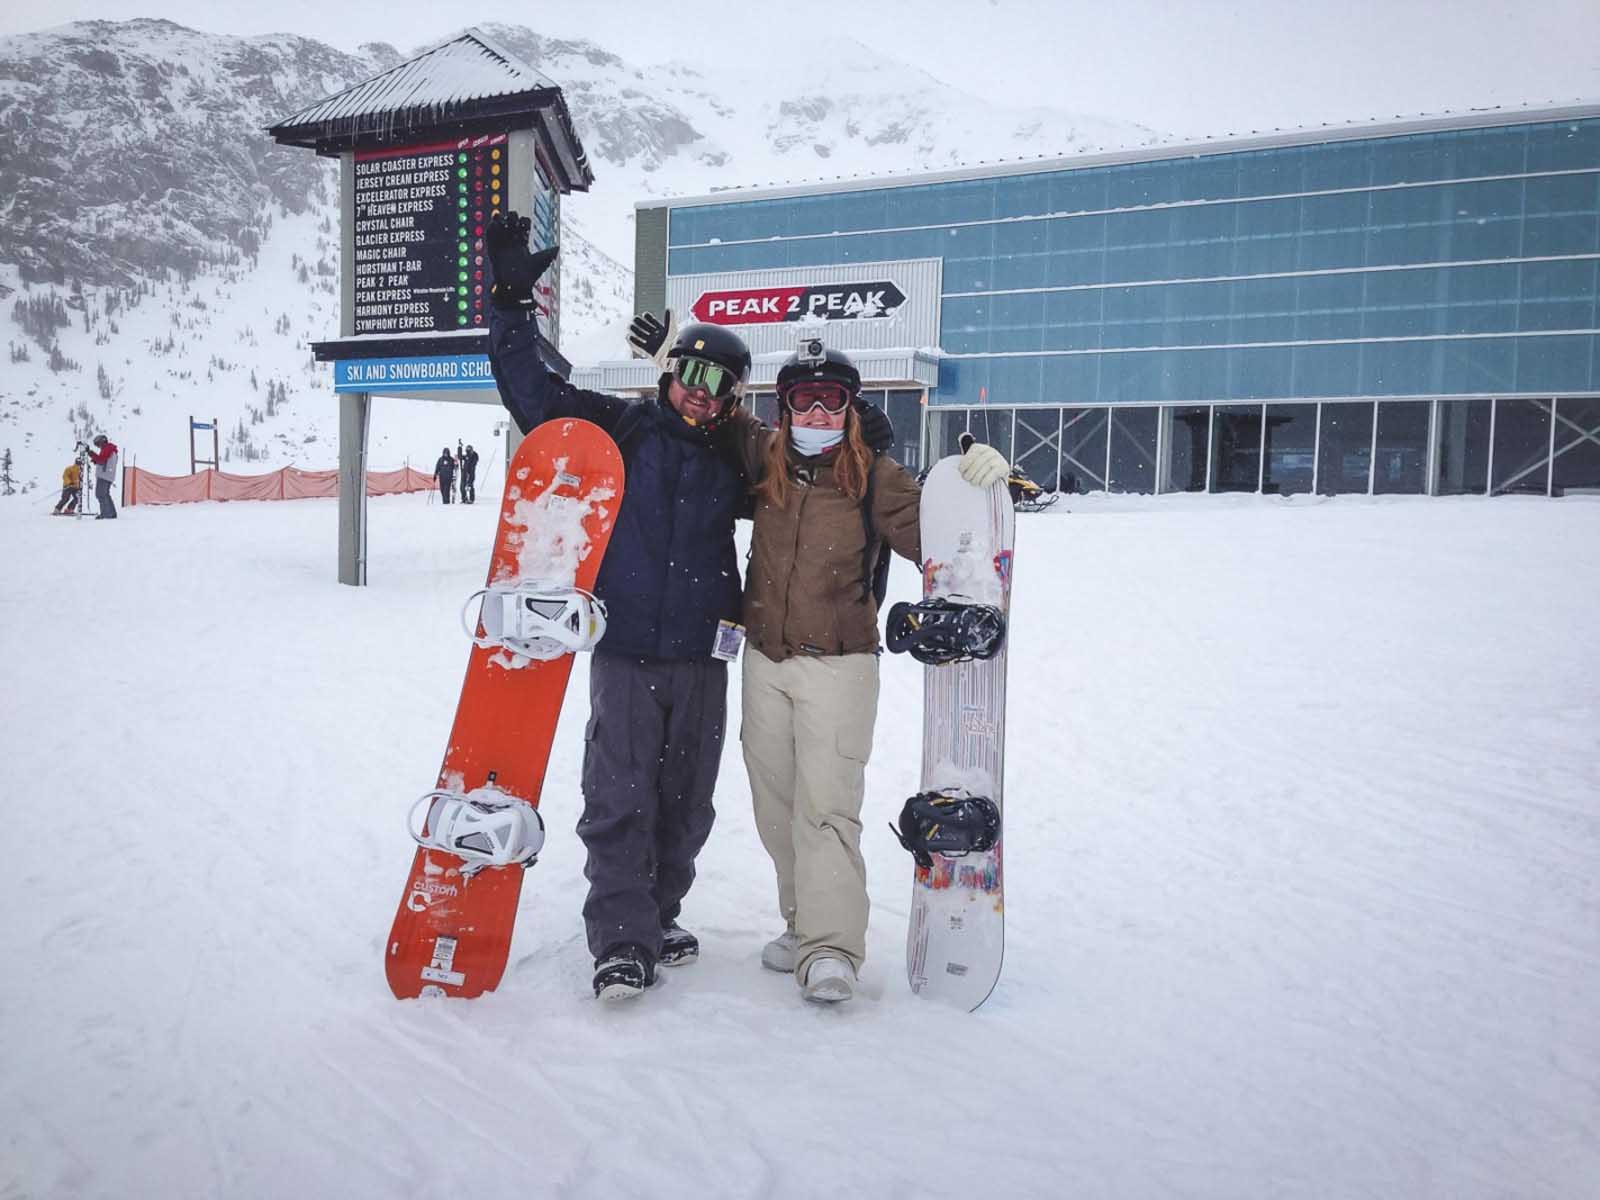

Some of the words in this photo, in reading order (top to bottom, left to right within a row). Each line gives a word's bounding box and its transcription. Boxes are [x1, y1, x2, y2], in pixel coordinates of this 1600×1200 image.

[356, 164, 381, 176] SOLAR
[381, 158, 417, 173] COASTER
[418, 154, 454, 168] EXPRESS
[356, 178, 384, 190] JERSEY
[385, 174, 413, 187] CREAM
[413, 170, 450, 184] EXPRESS
[356, 189, 409, 204] EXCELERATOR
[410, 185, 447, 199] EXPRESS
[367, 202, 397, 216] HEAVEN
[399, 199, 434, 212] EXPRESS
[356, 219, 389, 232] CRYSTAL
[390, 216, 415, 229] CHAIR
[356, 233, 388, 246] GLACIER
[389, 230, 425, 243] EXPRESS
[356, 248, 380, 261] MAGIC
[382, 246, 407, 259] CHAIR
[356, 262, 398, 276] HORSTMAN
[399, 260, 422, 272] T-BAR
[356, 276, 376, 288] PEAK
[379, 275, 385, 287] 2
[387, 275, 409, 287] PEAK
[356, 291, 376, 303] PEAK
[377, 288, 412, 301] EXPRESS
[709, 297, 780, 317] PEAK
[787, 295, 800, 313] 2
[808, 290, 887, 314] PEAK
[356, 304, 393, 317] HARMONY
[394, 302, 430, 315] EXPRESS
[355, 317, 398, 331] SYMPHONY
[399, 316, 434, 329] EXPRESS
[347, 365, 362, 381] SKI
[366, 364, 386, 380] AND
[389, 361, 458, 380] SNOWBOARD
[461, 360, 492, 377] SCHO
